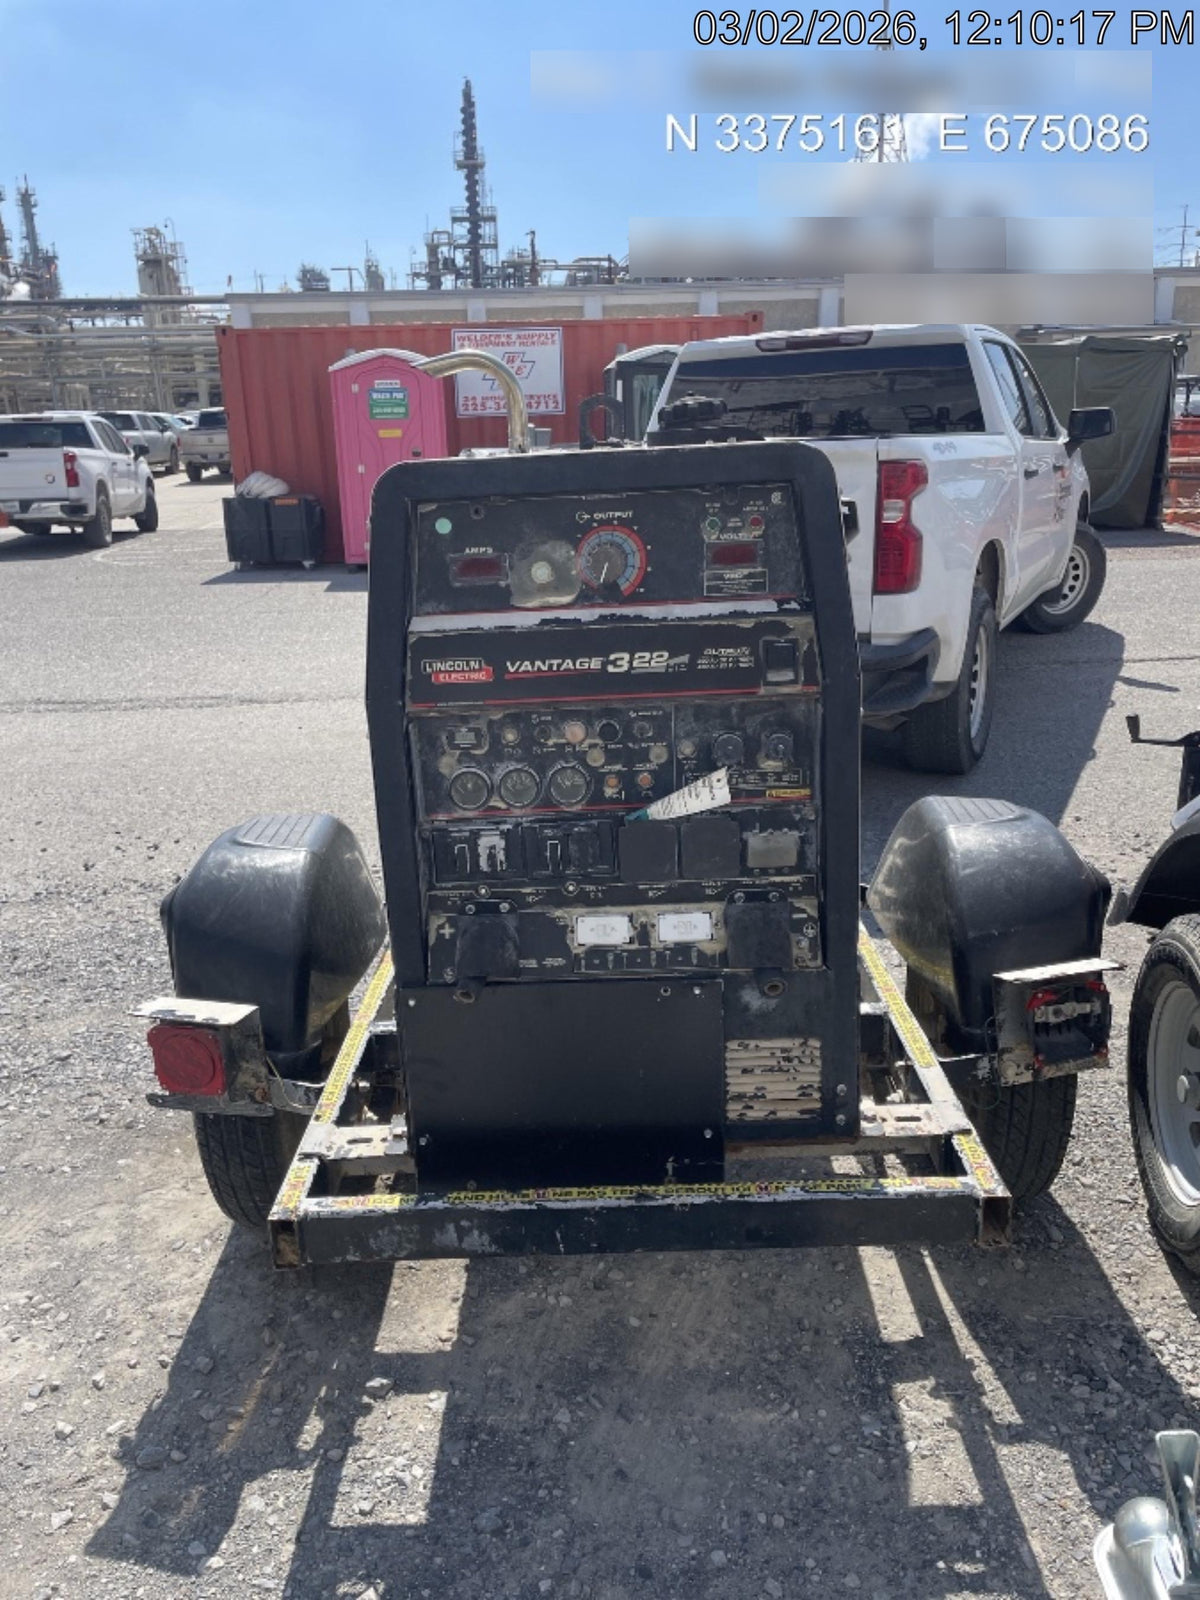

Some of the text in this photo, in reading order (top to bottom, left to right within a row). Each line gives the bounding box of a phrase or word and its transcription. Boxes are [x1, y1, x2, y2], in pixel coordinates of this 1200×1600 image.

[464, 546, 494, 554] AMPS
[425, 660, 480, 672] LINCOLN
[505, 656, 603, 673] VANTAGE
[606, 650, 670, 673] 322
[439, 671, 487, 682] ELECTRIC
